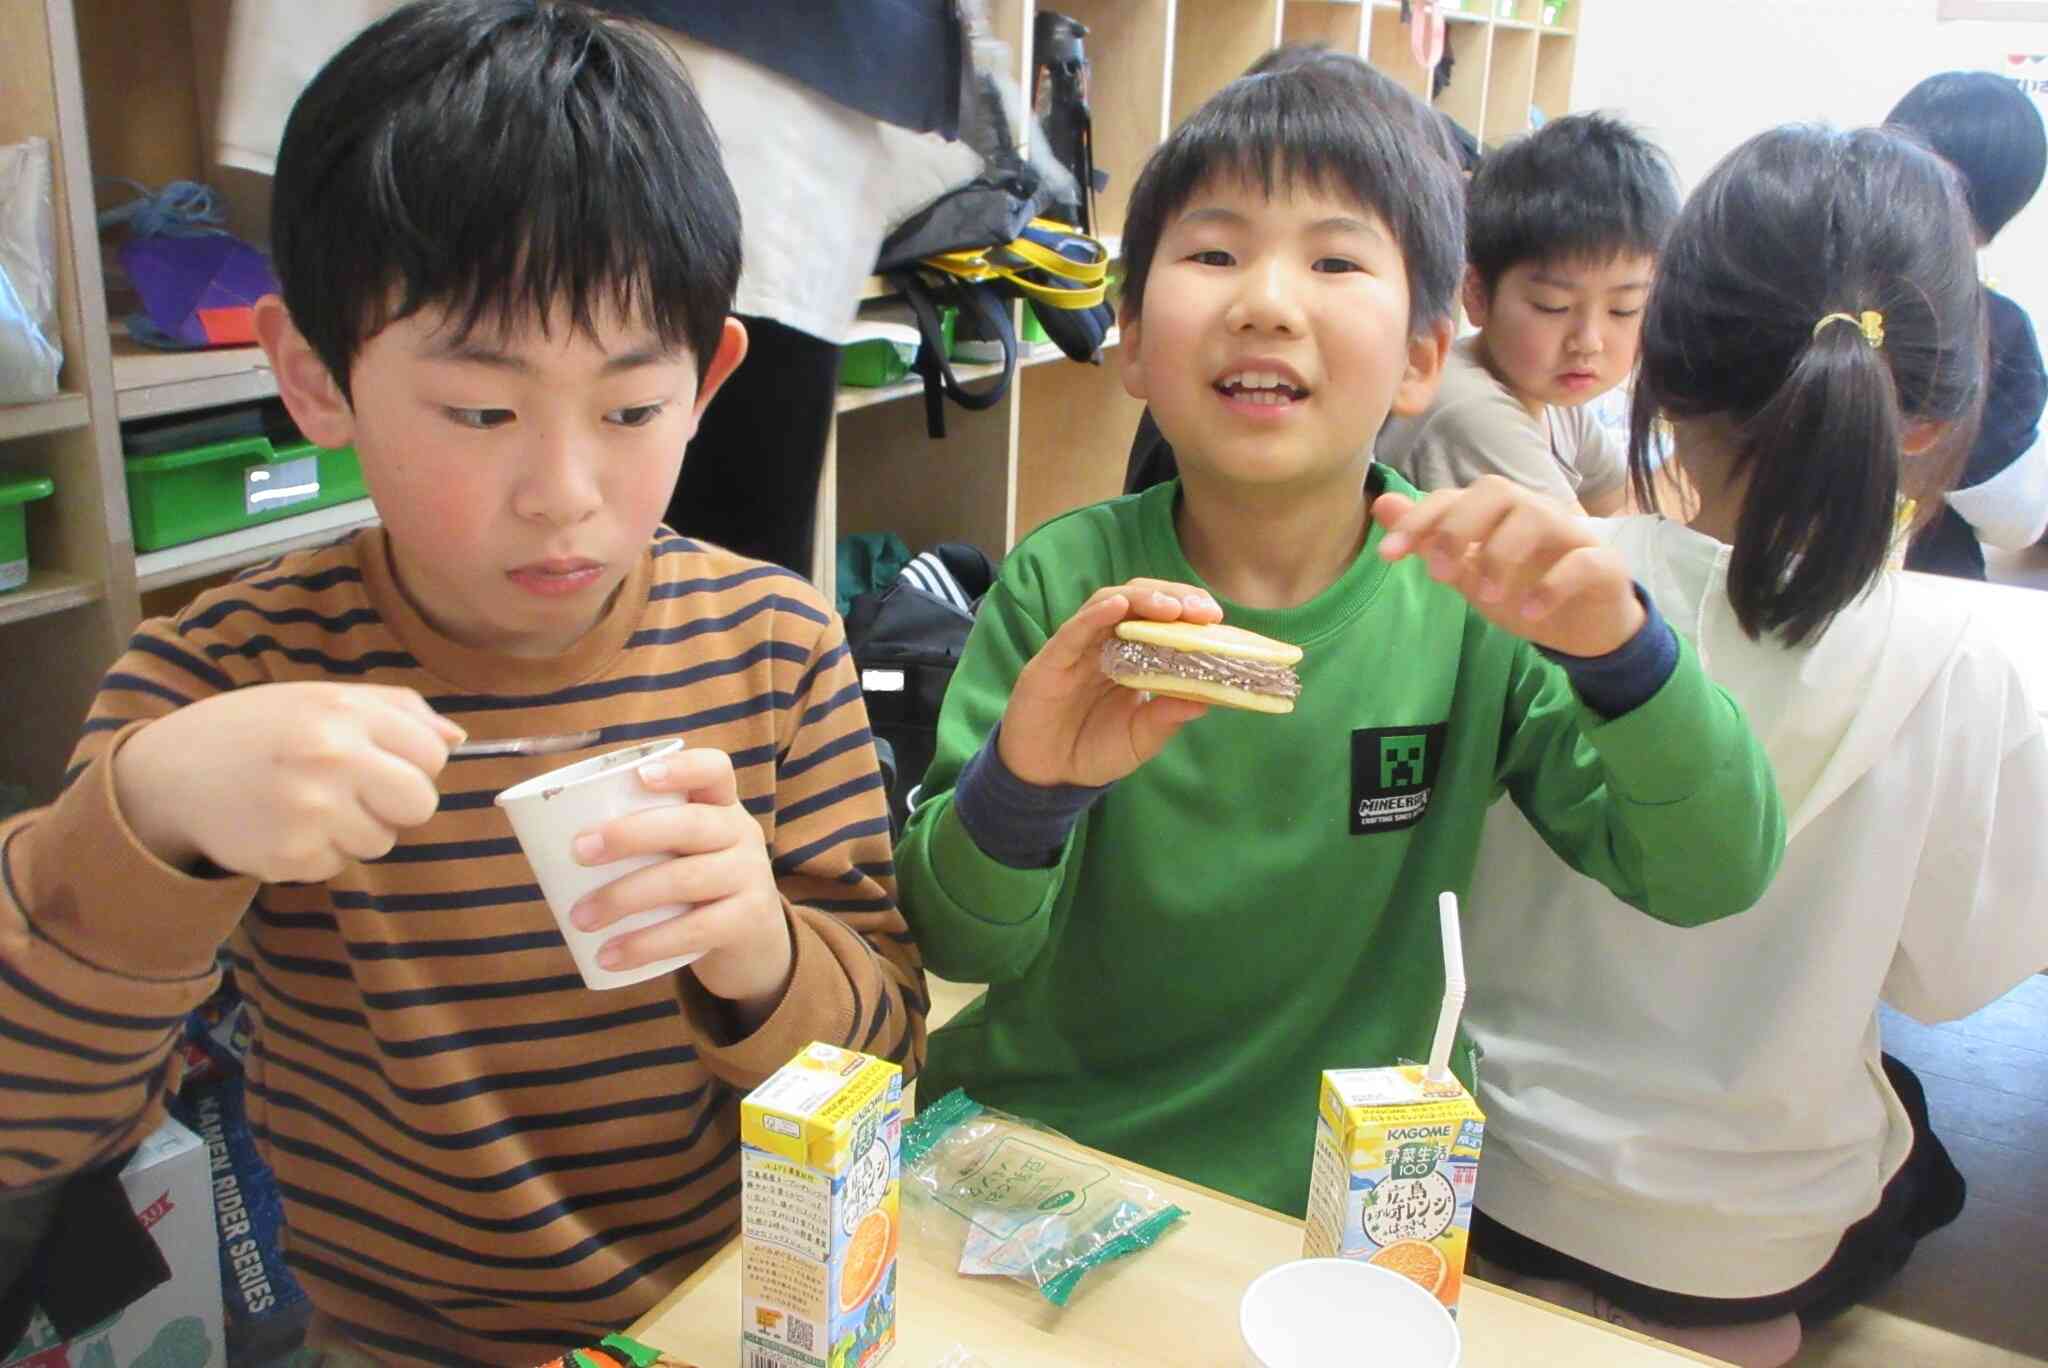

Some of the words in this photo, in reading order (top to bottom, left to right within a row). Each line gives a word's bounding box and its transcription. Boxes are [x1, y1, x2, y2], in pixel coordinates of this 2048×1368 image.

[197, 1095, 232, 1172] KAMEN
[1386, 1125, 1451, 1141] KAGOME
[1385, 1145, 1449, 1166] 野菜生活
[1399, 1163, 1428, 1176] 100
[1386, 1180, 1428, 1204] 広島
[212, 1173, 251, 1241] RIDER
[229, 1239, 276, 1313] SERIES
